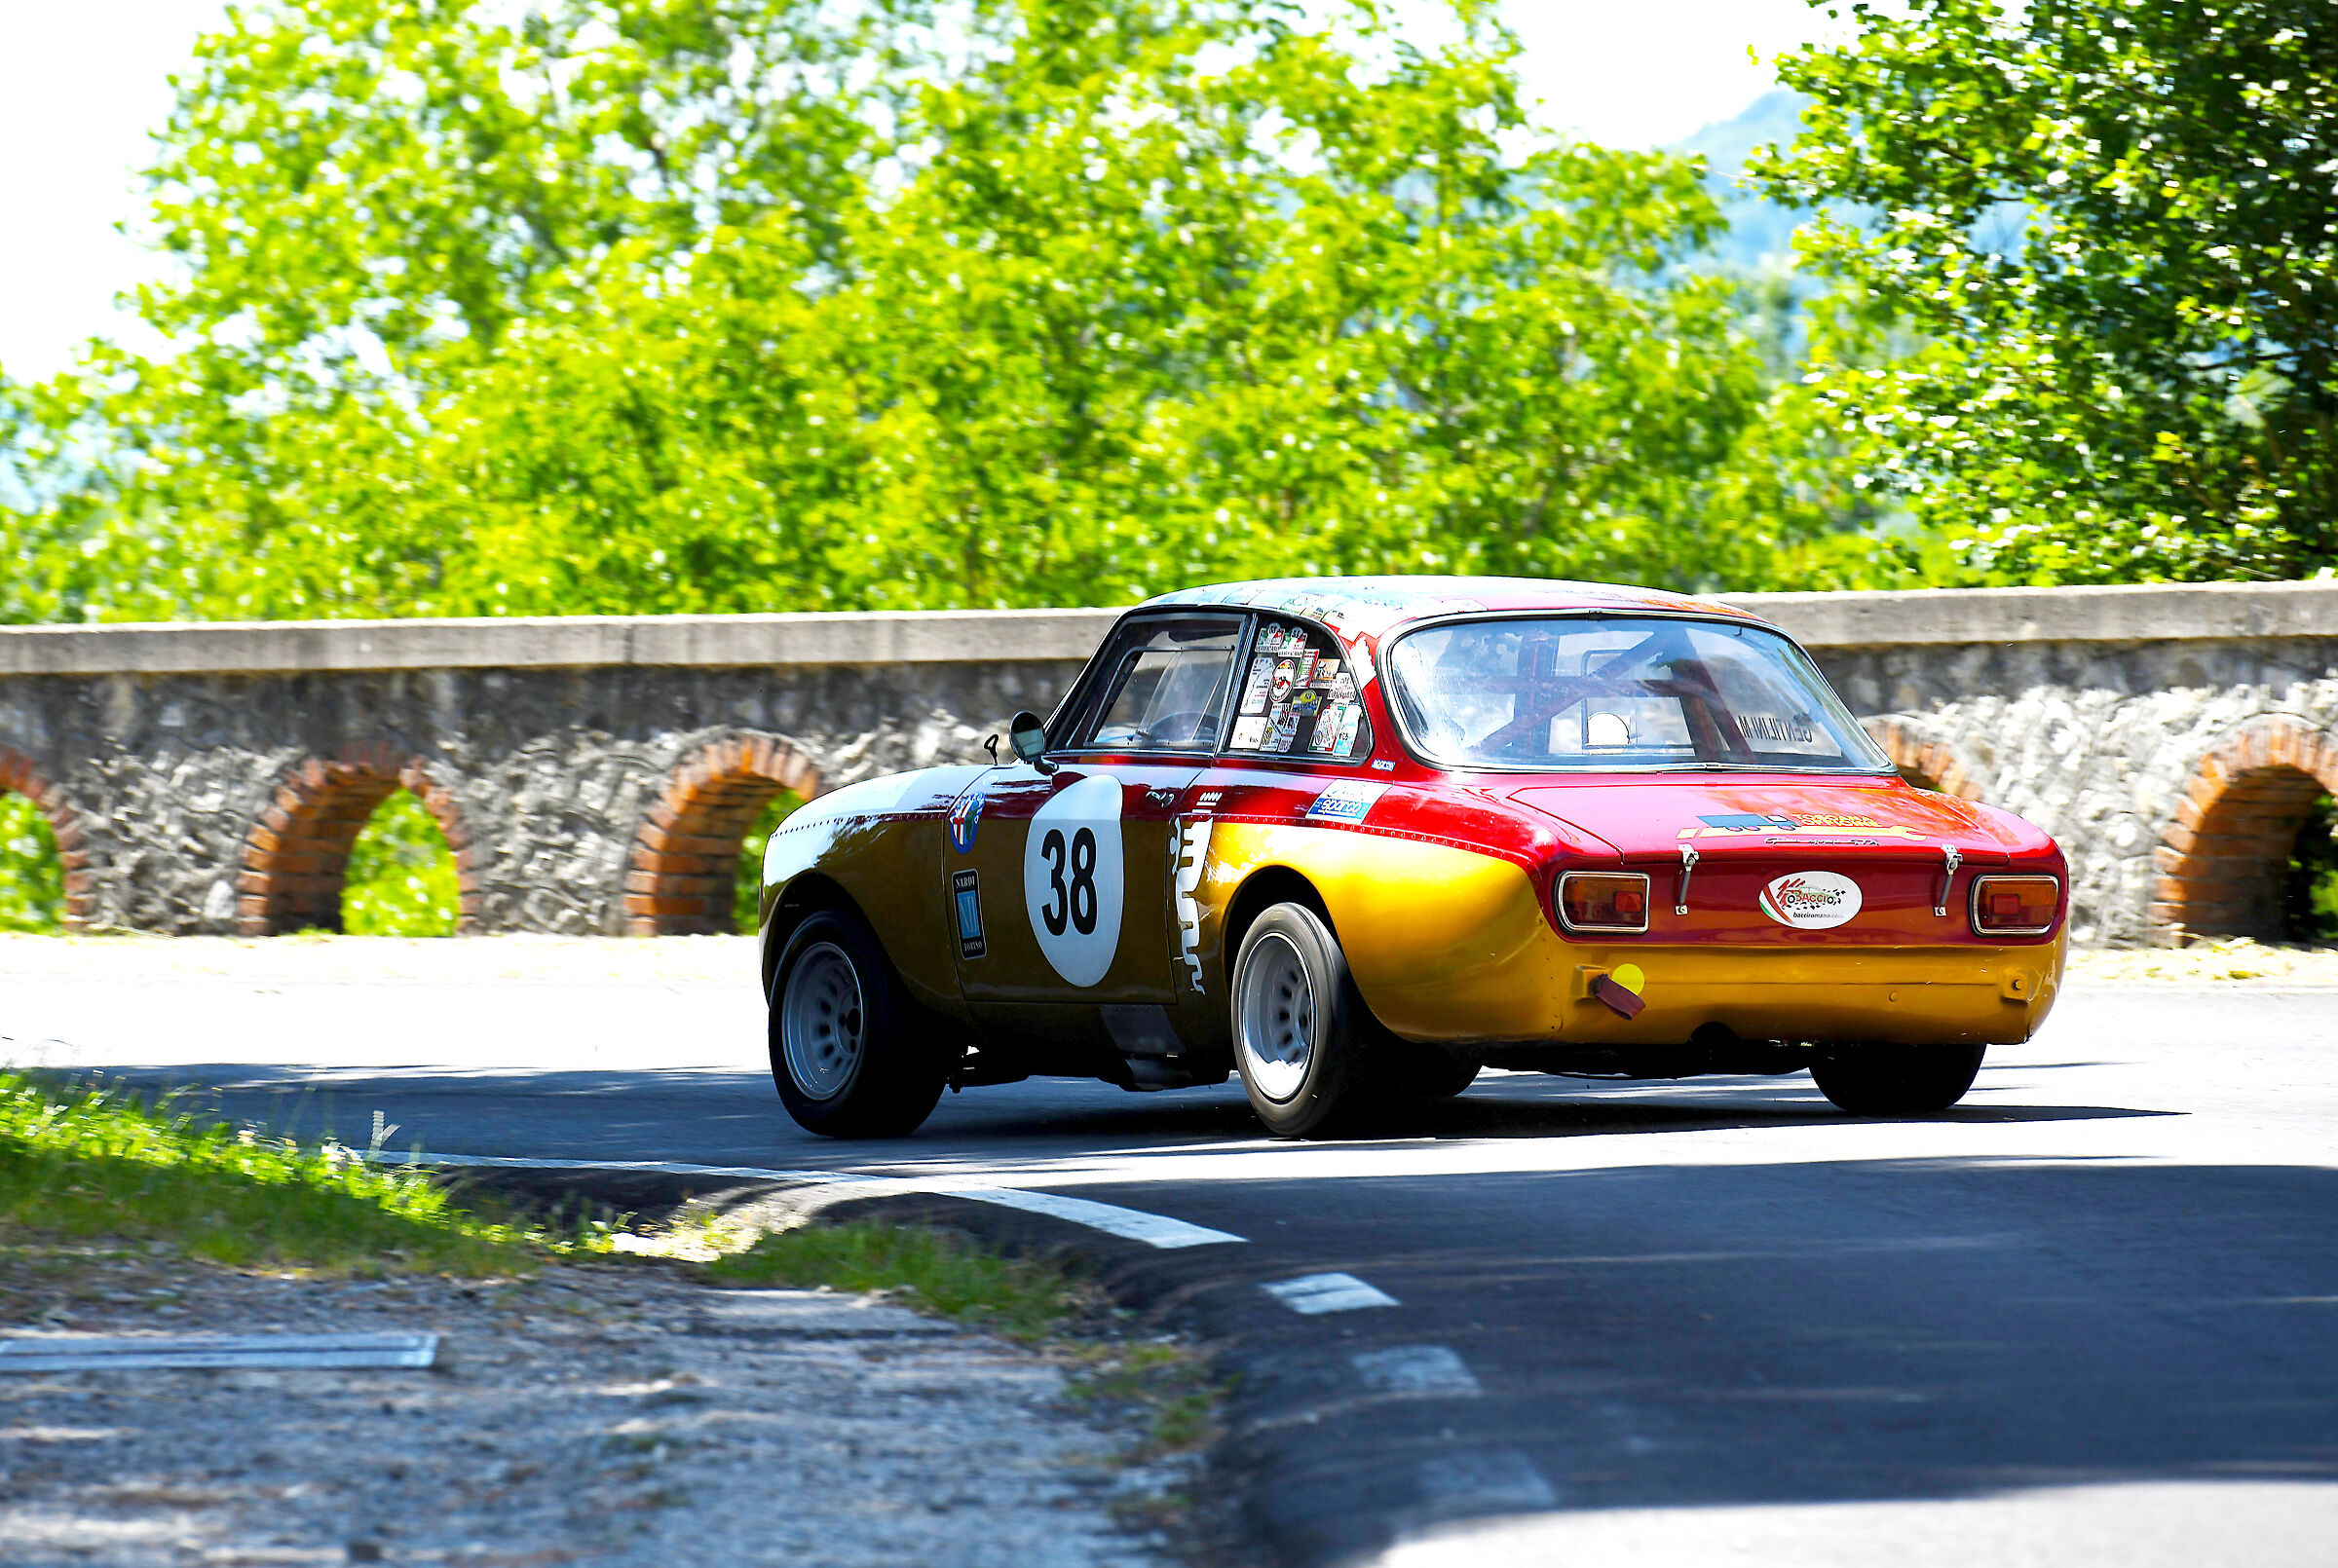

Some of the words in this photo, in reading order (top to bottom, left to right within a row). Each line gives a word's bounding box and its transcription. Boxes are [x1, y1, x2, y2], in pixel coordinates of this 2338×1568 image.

[1320, 799, 1363, 816] sparco
[956, 876, 975, 889] NARDI
[1040, 827, 1098, 936] 38
[963, 941, 983, 952] TORINO
